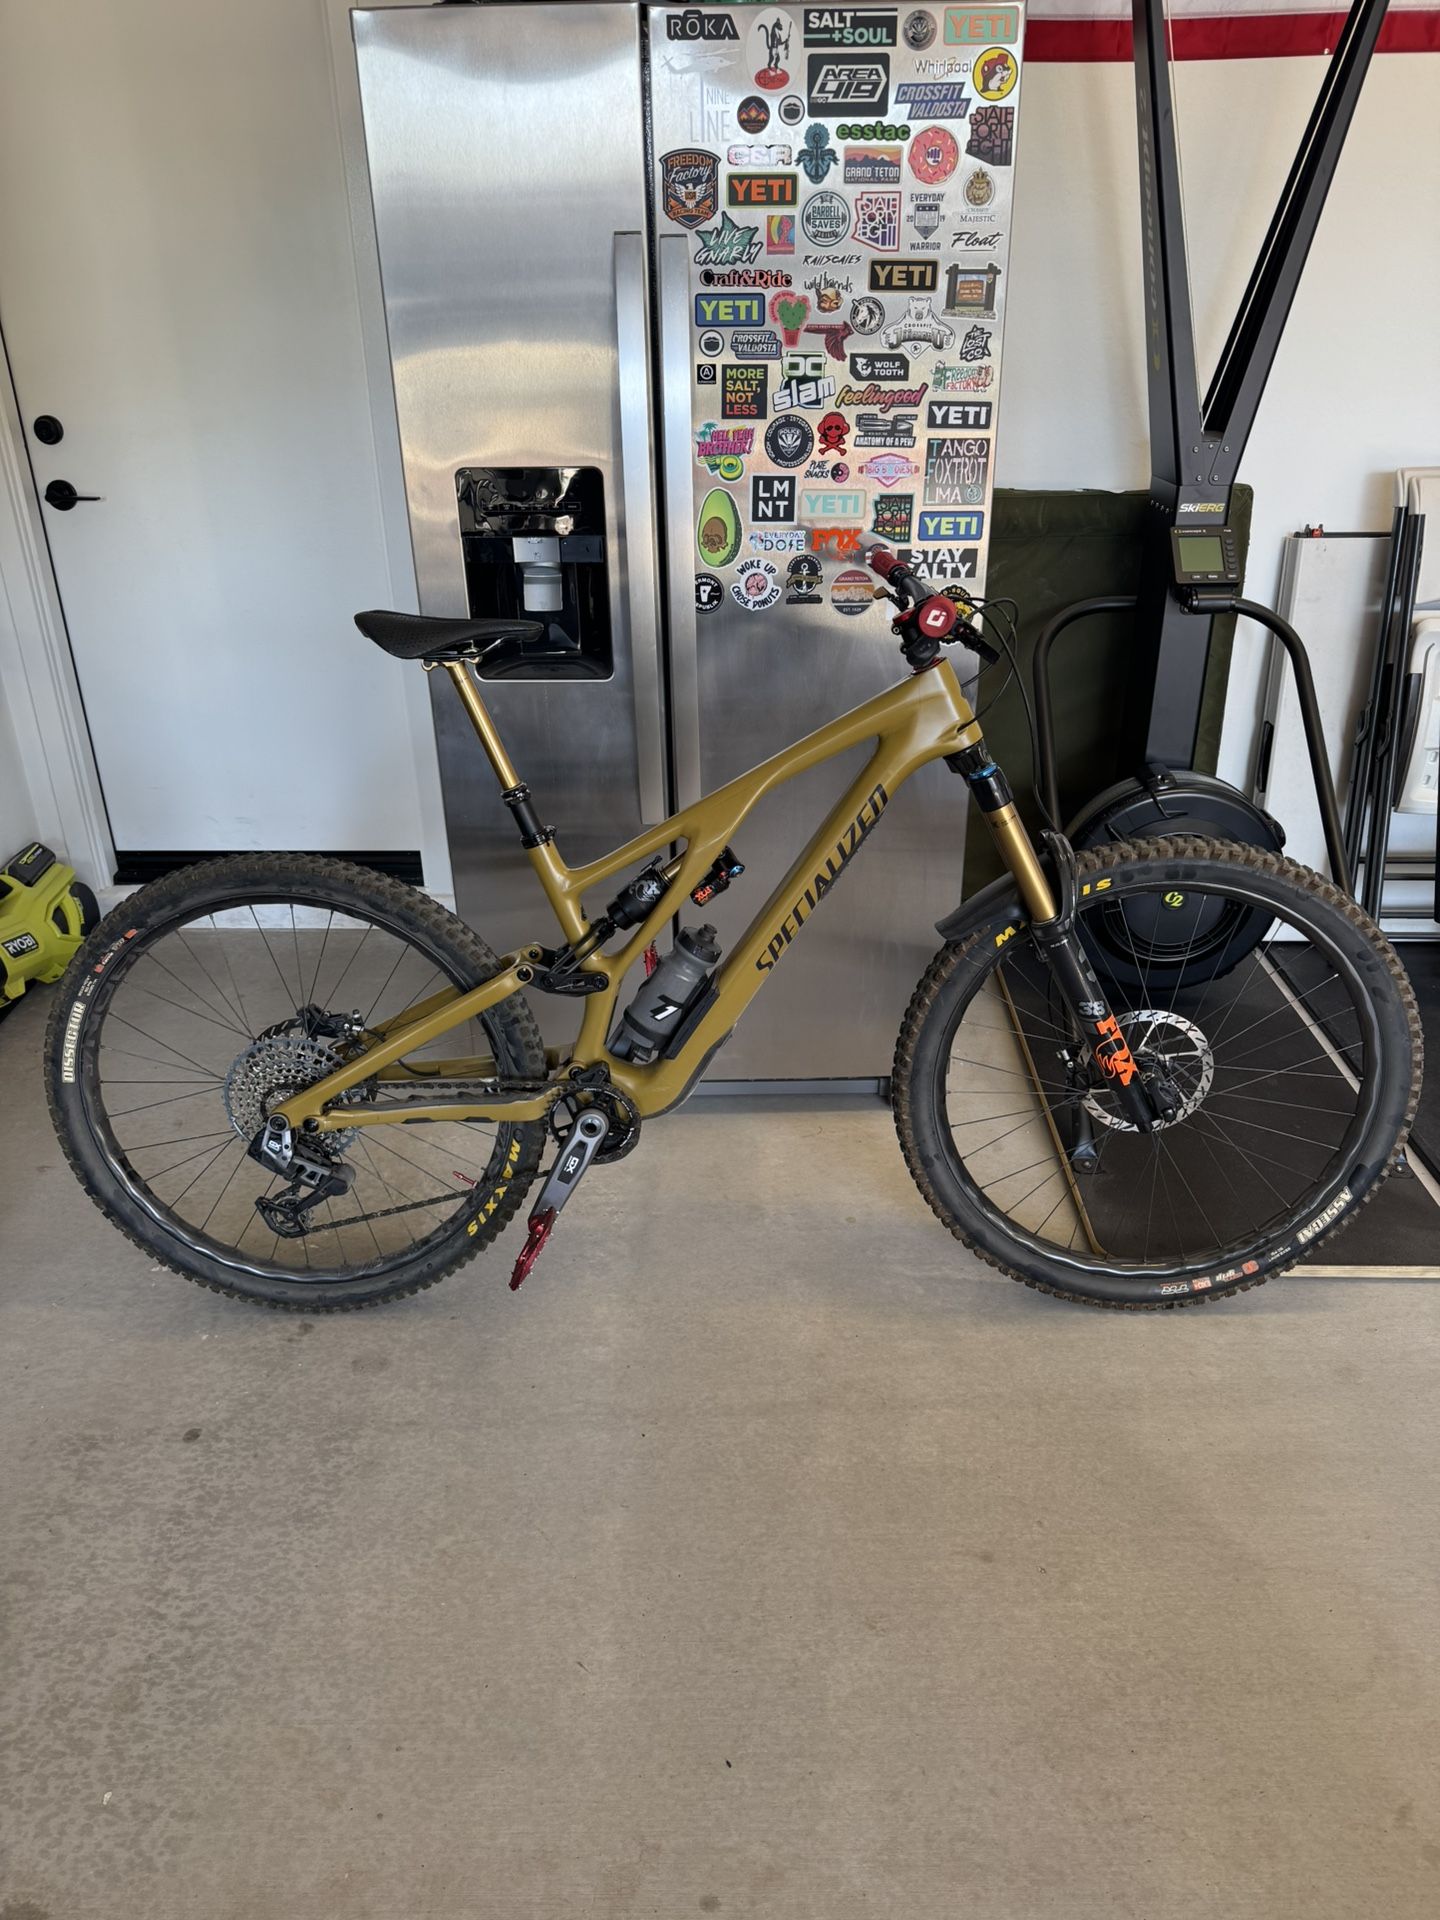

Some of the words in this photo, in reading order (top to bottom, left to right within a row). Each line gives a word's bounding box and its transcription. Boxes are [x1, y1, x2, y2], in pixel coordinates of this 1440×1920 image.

[808, 12, 854, 29] SALT
[951, 15, 1011, 38] YETI
[831, 27, 892, 44] +SOUL
[823, 68, 882, 80] AREA
[915, 59, 973, 78] Whirlpool
[706, 88, 731, 105] NINE
[819, 81, 881, 99] 419
[900, 84, 963, 100] CROSSFIT
[910, 102, 966, 118] VALDOSTA
[975, 107, 1014, 124] STATE
[690, 110, 731, 143] LINE
[837, 122, 909, 140] esstac
[972, 123, 1013, 139] FORTY
[667, 153, 713, 167] FREEDOM
[669, 165, 712, 183] Factory
[845, 166, 873, 177] GRAND
[875, 166, 900, 177] TETON
[731, 179, 793, 201] YETI
[910, 193, 946, 202] EVERYDAY
[672, 208, 694, 218] RACING
[694, 208, 709, 216] TEAM
[811, 205, 841, 217] BARBELL
[863, 198, 898, 211] STATE
[811, 220, 841, 229] SAVES
[906, 215, 914, 223] 20
[959, 214, 996, 223] MAJESTIC
[709, 228, 746, 246] LIVE
[951, 231, 1003, 248] Float
[695, 243, 763, 265] GNARLY
[909, 242, 941, 251] WARRIOR
[874, 265, 933, 286] YETI
[701, 300, 759, 321] YETI
[732, 334, 770, 343] CROSSFIT
[737, 344, 778, 353] VALDOSTA
[726, 368, 765, 379] MORE
[874, 368, 904, 376] TOOTH
[726, 381, 761, 392] SALT,
[773, 376, 836, 411] slam
[726, 393, 754, 403] NOT
[835, 383, 928, 413] feelingood
[726, 405, 758, 415] LESS
[931, 405, 987, 425] YETI
[779, 428, 801, 436] POLICE
[855, 436, 885, 446] ANATOMY
[885, 437, 894, 446] OF
[894, 437, 899, 446] A
[900, 437, 915, 447] PEW
[930, 439, 988, 457] TANGO
[809, 460, 829, 470] PLATE
[925, 457, 987, 484] FOXTROT
[804, 470, 829, 479] SNACKS
[758, 480, 790, 498] LM
[925, 487, 962, 504] LIMA
[758, 501, 789, 518] NT
[805, 494, 859, 514] YETI
[1179, 503, 1226, 513] SkiERG
[924, 517, 978, 535] YETI
[764, 531, 805, 539] EVERYDAY
[811, 527, 863, 551] FOX
[910, 548, 963, 563] STAY
[736, 559, 762, 576] WOKE
[763, 563, 778, 576] UP
[908, 562, 972, 579] ALTY
[732, 585, 750, 607] CHOSE
[752, 586, 780, 610] DONUTS
[755, 783, 889, 971] SPECIALIZED
[4, 935, 36, 954] RYOBI
[61, 1000, 87, 1084] DISSECTOR
[1095, 1014, 1137, 1088] FOX
[566, 1156, 580, 1175] GX
[1296, 1185, 1354, 1245] ASSEGAI
